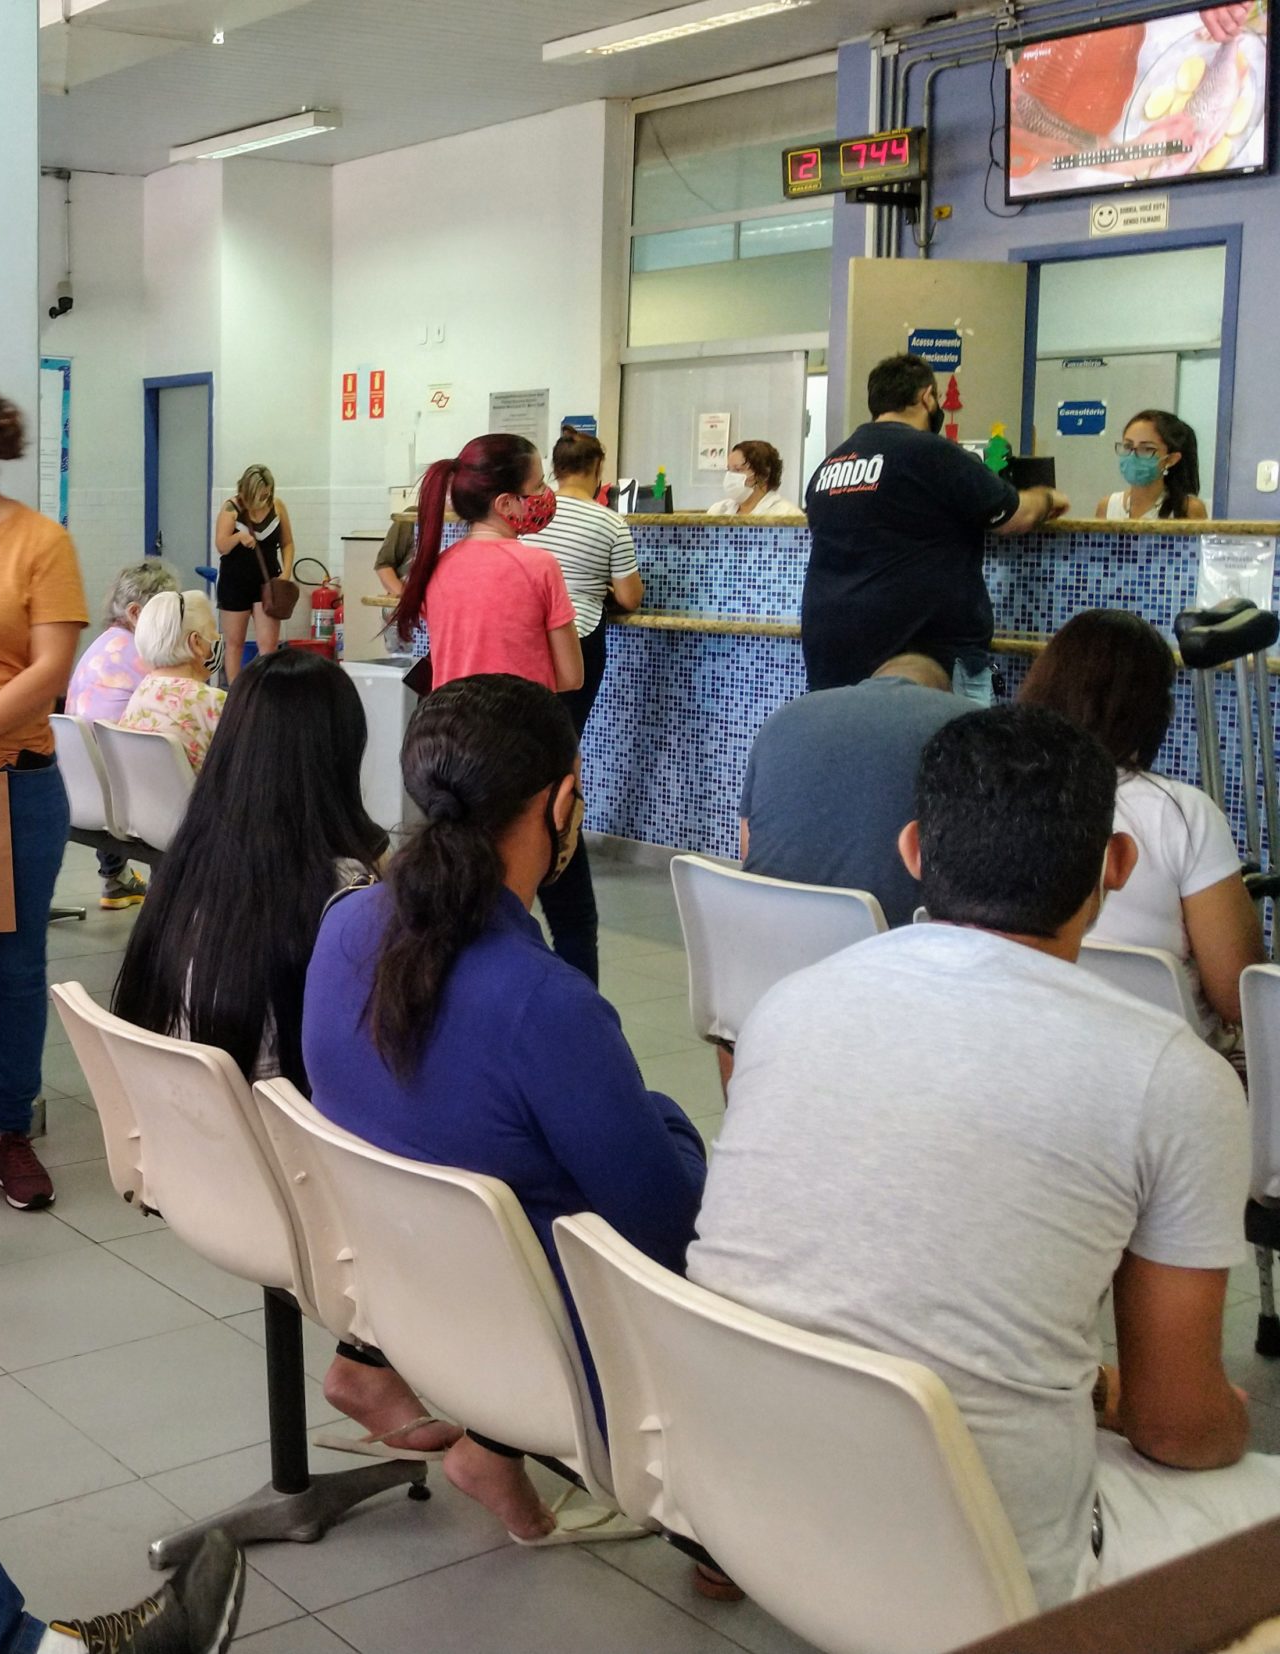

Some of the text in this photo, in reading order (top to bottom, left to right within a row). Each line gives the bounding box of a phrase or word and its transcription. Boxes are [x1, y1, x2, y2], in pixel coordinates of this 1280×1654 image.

[852, 138, 907, 169] 744
[798, 153, 817, 179] 2
[911, 337, 934, 347] Acesso
[1059, 408, 1105, 417] Consultório
